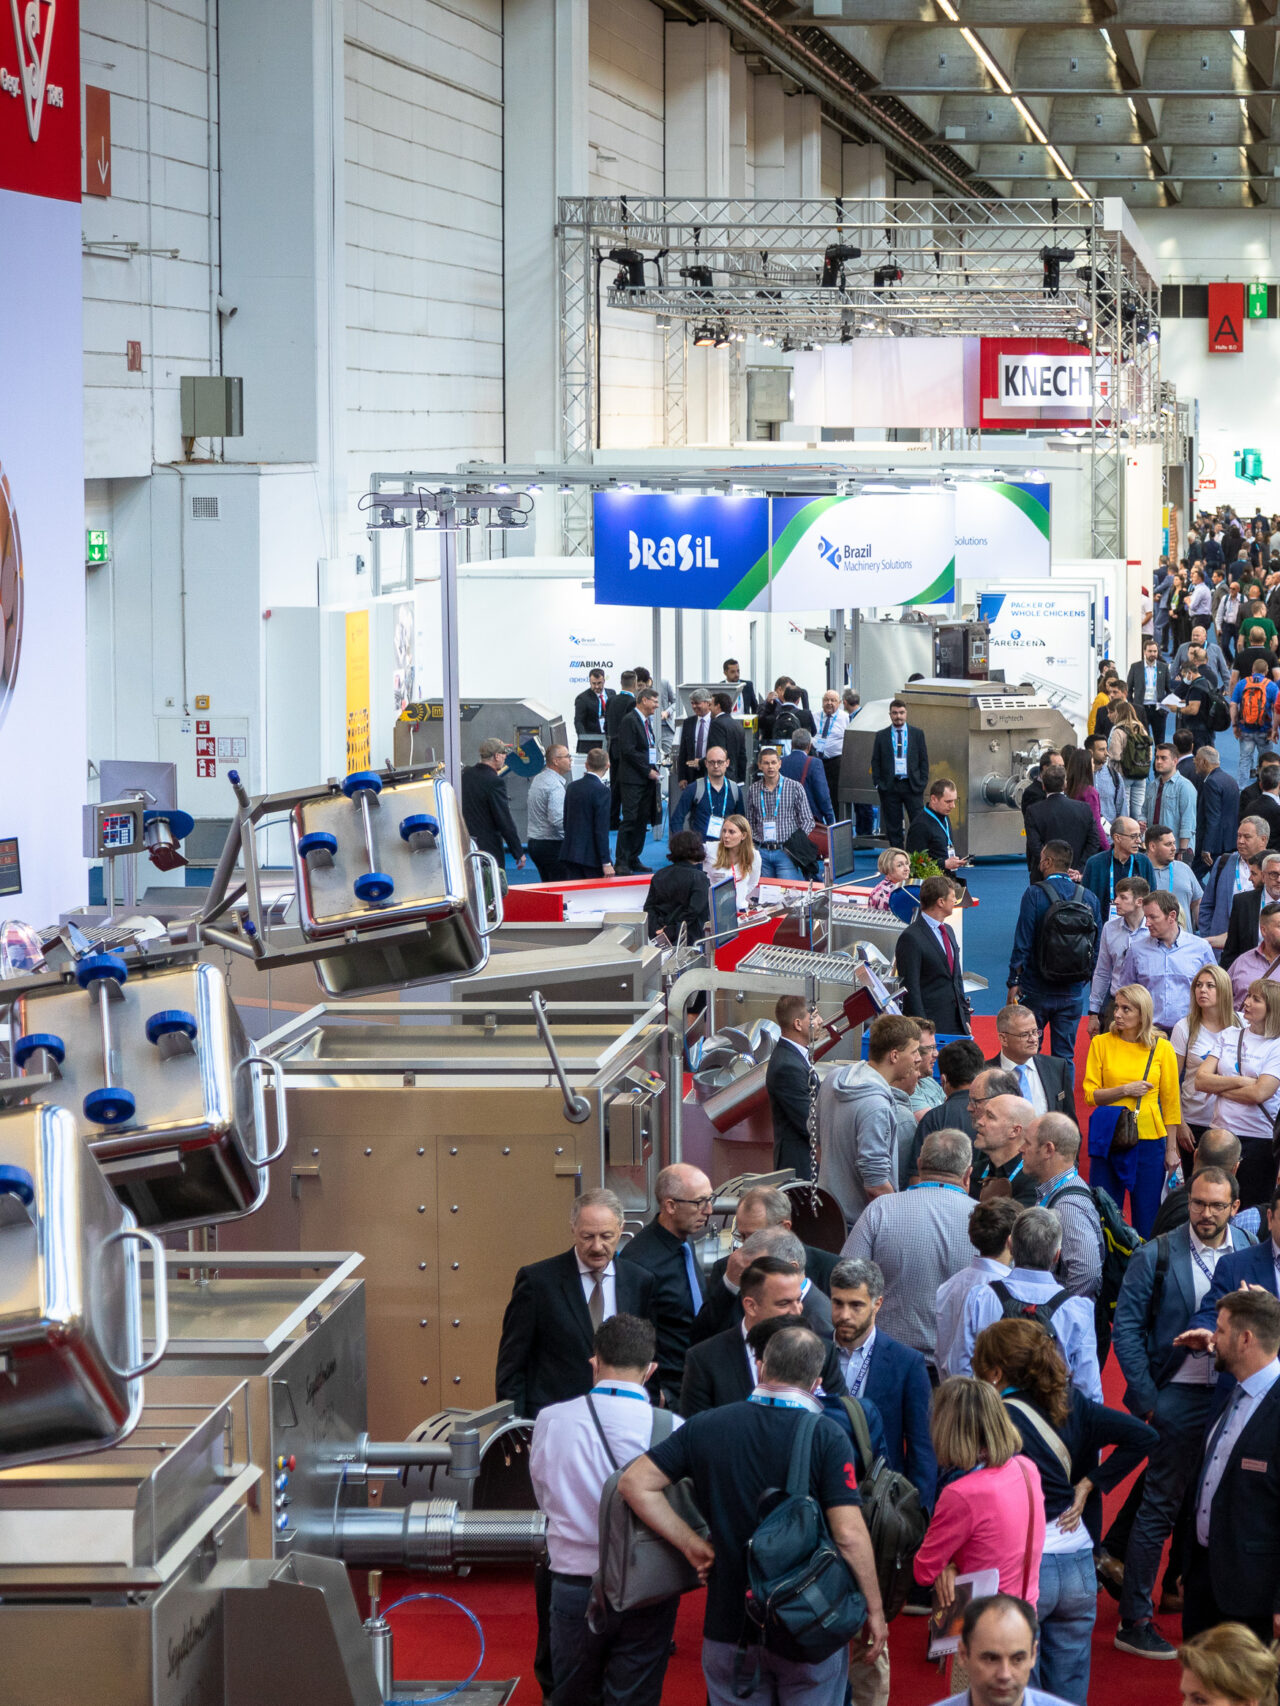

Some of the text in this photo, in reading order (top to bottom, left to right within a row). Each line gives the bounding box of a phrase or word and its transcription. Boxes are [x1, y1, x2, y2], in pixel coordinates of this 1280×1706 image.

[1214, 315, 1238, 342] A
[1004, 365, 1099, 397] KNECHT
[844, 544, 872, 559] Brazil
[843, 559, 913, 573] Machinery Solutions
[580, 660, 614, 668] ABIMAQ
